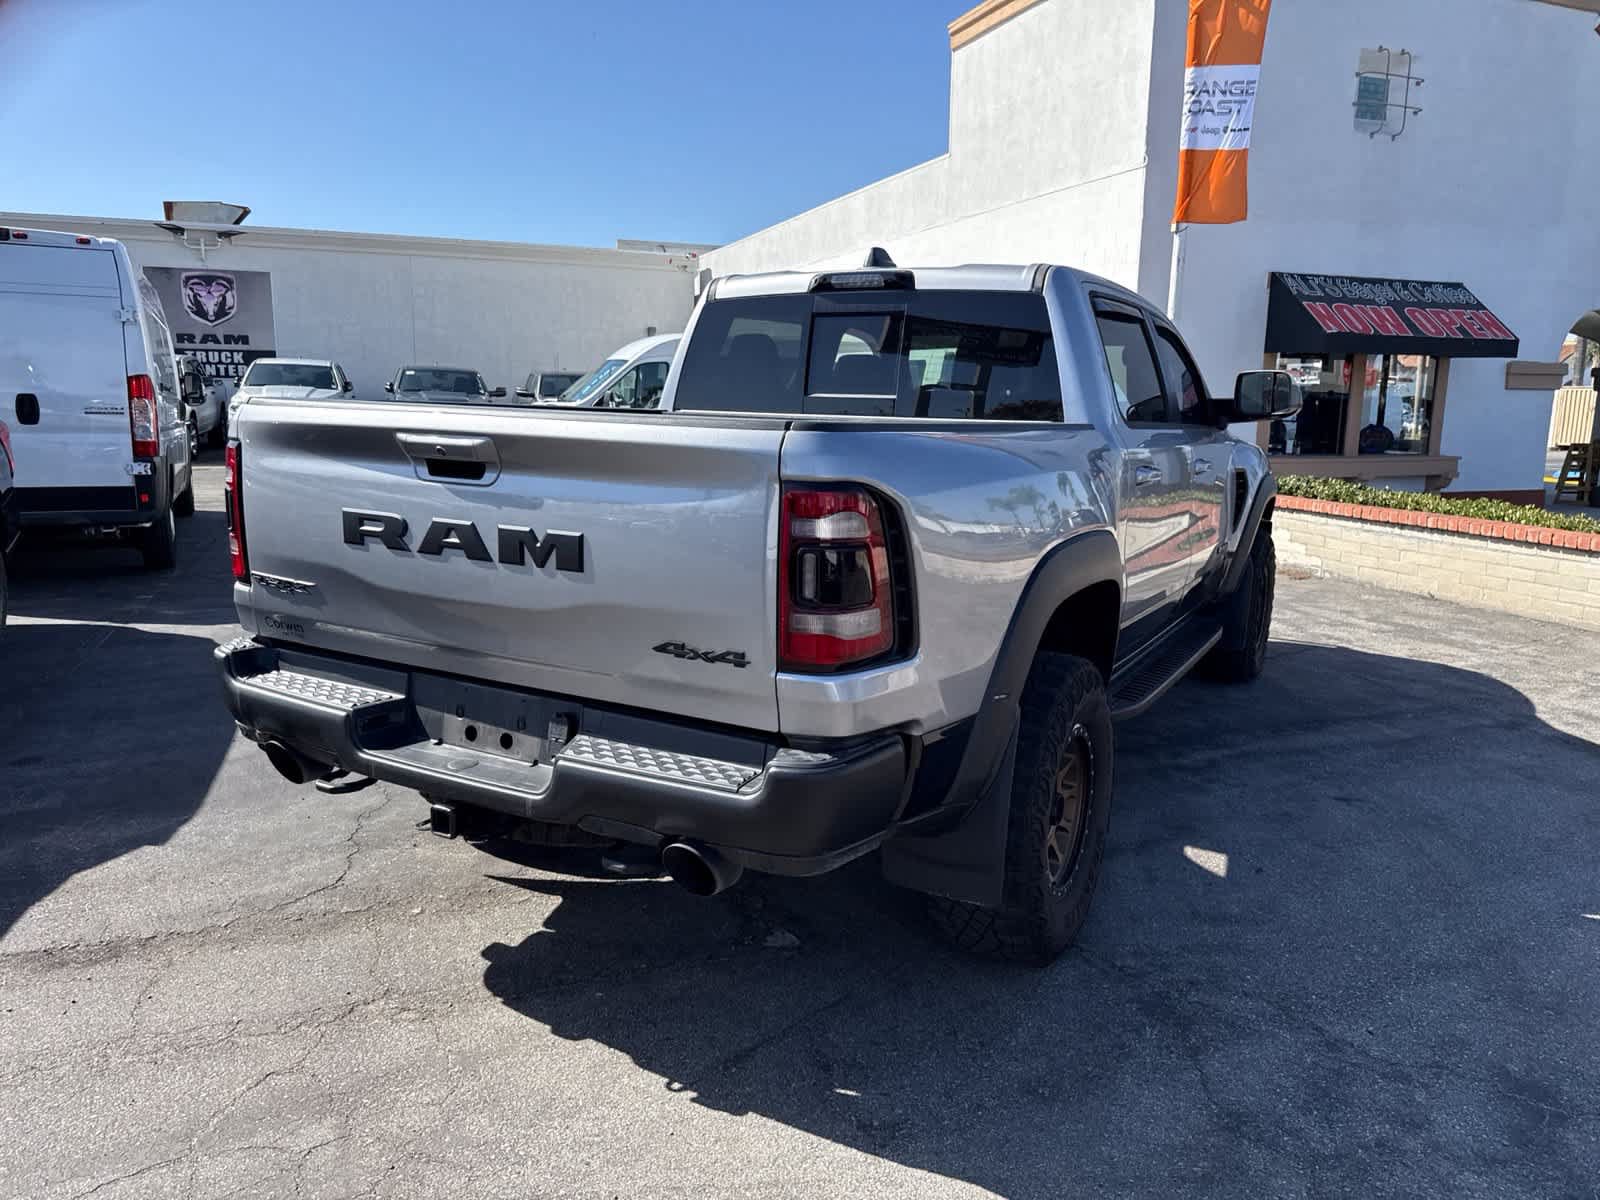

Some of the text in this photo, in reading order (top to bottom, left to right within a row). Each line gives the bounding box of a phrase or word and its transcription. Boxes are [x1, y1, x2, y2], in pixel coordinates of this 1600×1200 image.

[1186, 80, 1257, 97] RANGE
[1187, 100, 1247, 115] OAST
[1407, 282, 1478, 304] Coffee
[1302, 301, 1515, 340] NOW OPEN
[176, 333, 250, 346] RAM
[184, 350, 245, 364] TRUCK
[204, 363, 249, 377] NTER
[342, 507, 585, 574] RAM
[651, 642, 752, 669] 4x4
